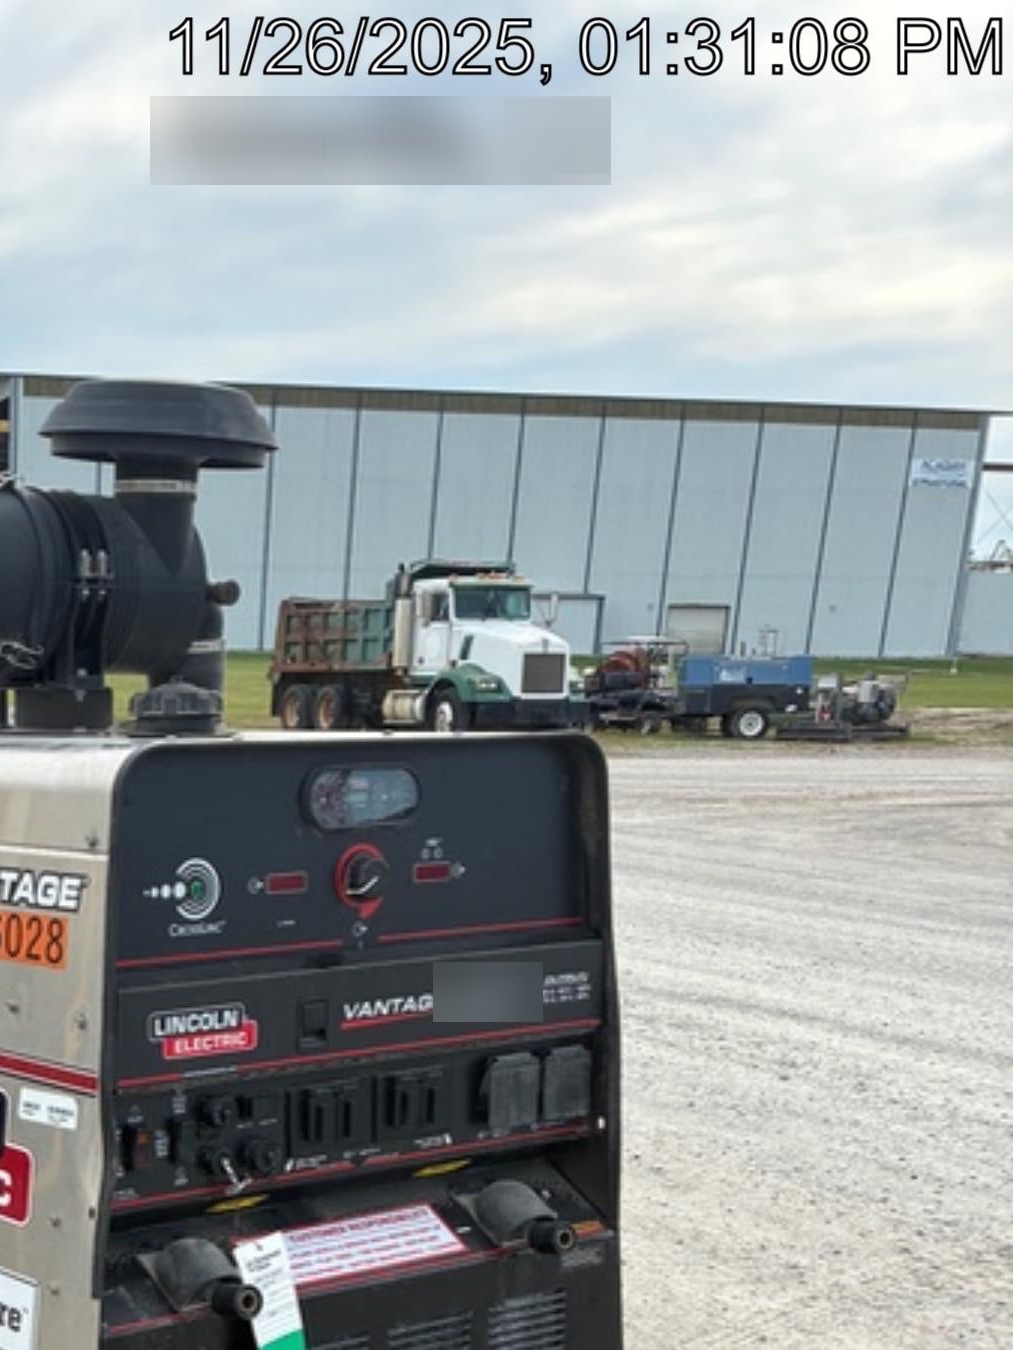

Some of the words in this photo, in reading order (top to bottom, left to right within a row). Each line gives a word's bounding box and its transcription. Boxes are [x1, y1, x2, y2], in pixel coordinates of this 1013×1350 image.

[342, 992, 434, 1021] VANTAG
[154, 1008, 240, 1036] LINCOLN
[174, 1030, 248, 1055] ELECTRIC
